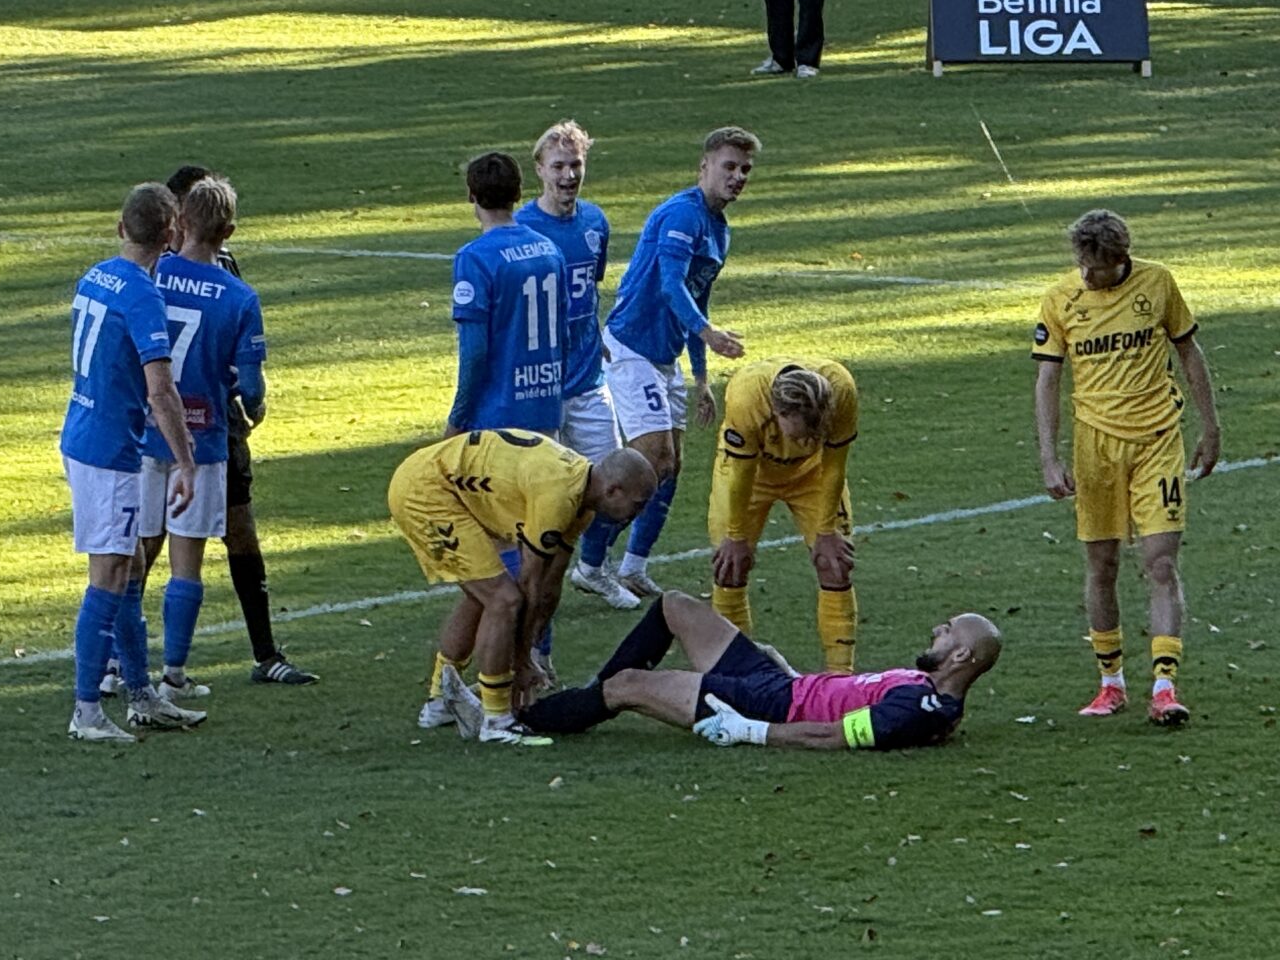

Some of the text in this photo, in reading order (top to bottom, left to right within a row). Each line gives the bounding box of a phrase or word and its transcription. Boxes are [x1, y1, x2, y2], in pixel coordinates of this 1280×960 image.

[979, 19, 1103, 55] LIGA
[155, 272, 226, 300] LINNET
[523, 273, 557, 351] 11
[73, 294, 108, 378] 77
[167, 305, 202, 382] 7
[1075, 327, 1154, 356] COMEON!
[643, 383, 663, 411] 5
[1158, 476, 1182, 507] 14
[122, 507, 140, 537] 7
